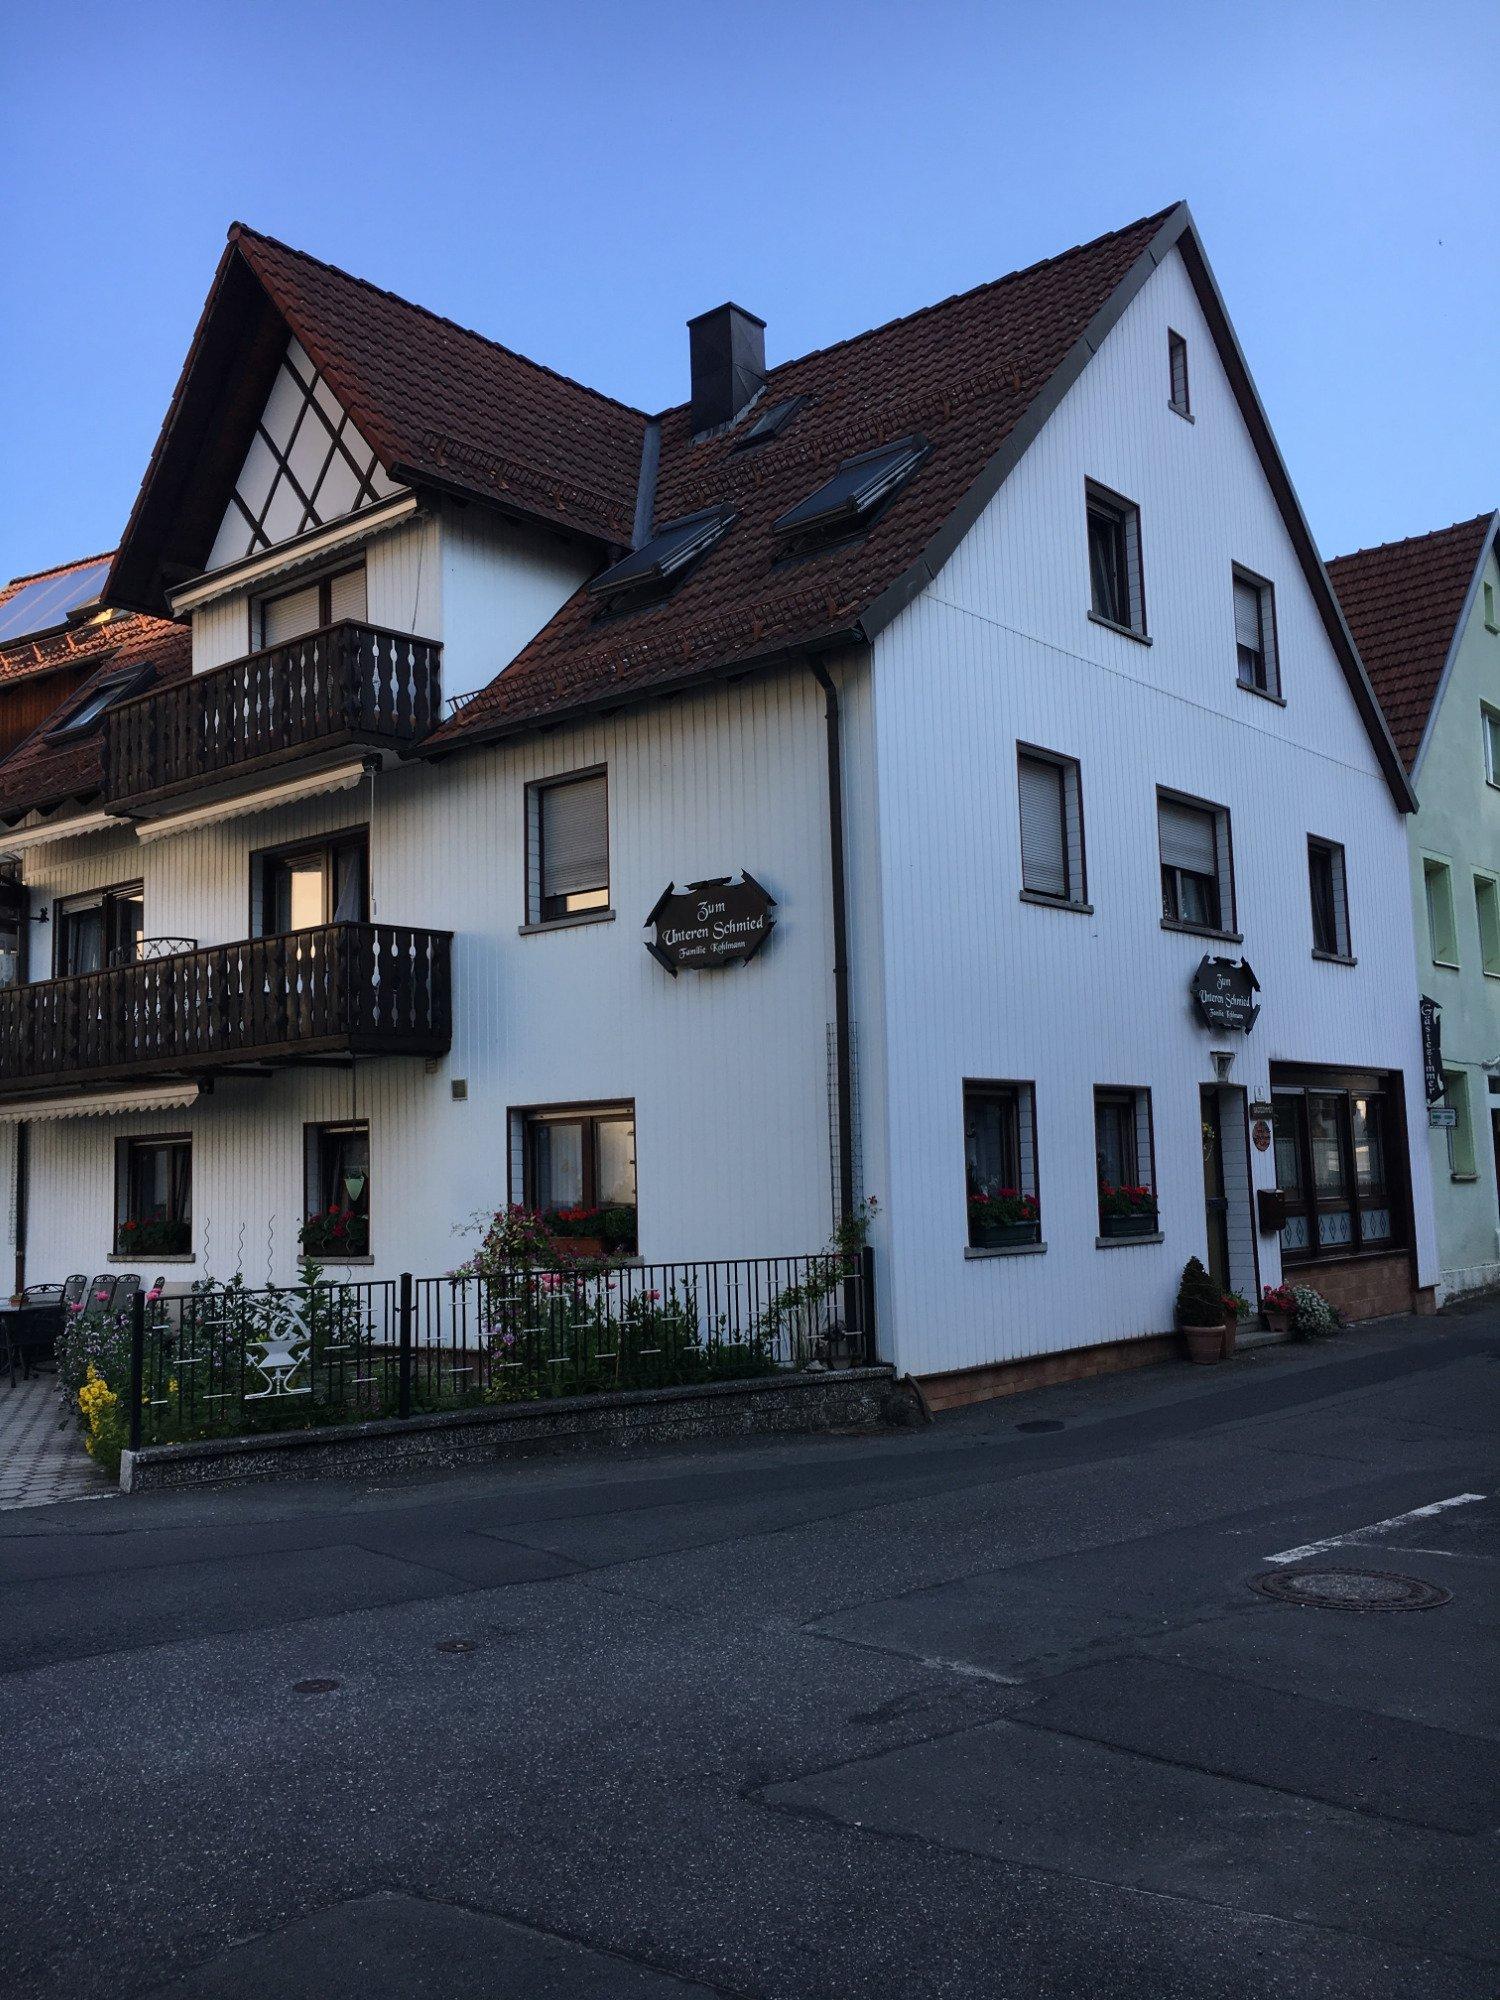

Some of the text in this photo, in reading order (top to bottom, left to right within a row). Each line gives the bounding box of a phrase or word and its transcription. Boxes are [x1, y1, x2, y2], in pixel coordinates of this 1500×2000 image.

[697, 901, 726, 922] Zum
[662, 914, 764, 945] Unteren Schmied
[678, 946, 706, 959] Familie
[1216, 974, 1231, 990] Zum
[1199, 989, 1250, 1008] Unteren Schmied
